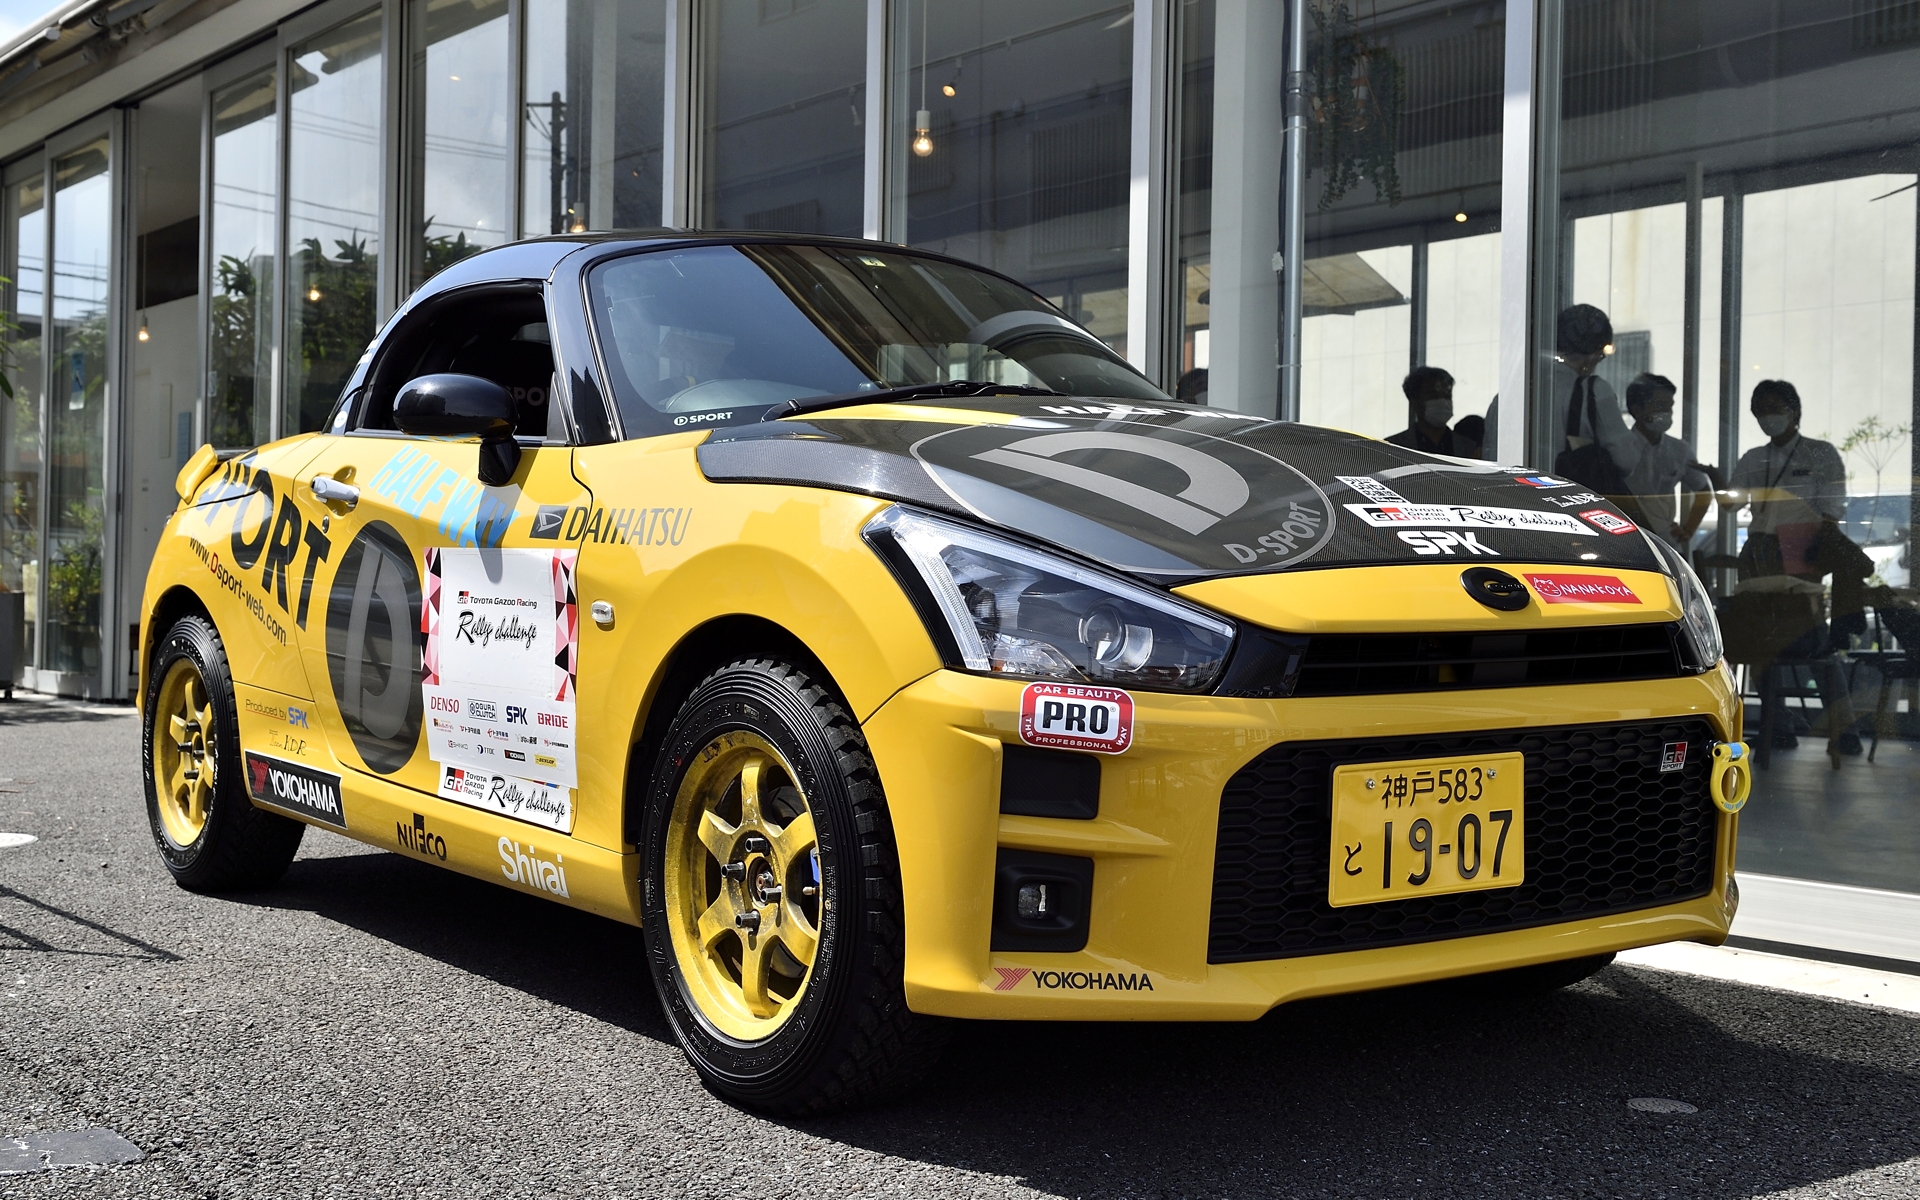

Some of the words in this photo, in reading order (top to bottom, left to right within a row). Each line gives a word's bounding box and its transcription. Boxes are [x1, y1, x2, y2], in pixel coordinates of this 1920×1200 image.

[689, 411, 733, 423] SPORT
[968, 430, 1250, 536] D
[368, 443, 460, 520] HALF
[438, 477, 521, 549] WAY
[564, 505, 693, 547] DAIHATSU
[1450, 507, 1516, 527] Rally
[1221, 501, 1322, 565] D-SPORT
[1397, 530, 1501, 556] SPK
[196, 455, 332, 633] SPORT
[189, 533, 287, 647] www.Dsport-web.com
[1559, 583, 1633, 597] NANAKOYA
[470, 596, 493, 605] TOYOTA
[493, 597, 516, 606] GAZOO
[516, 598, 538, 609] Racing
[343, 539, 415, 739] D
[455, 610, 493, 647] Rally
[494, 614, 538, 649] challenge
[1033, 686, 1062, 694] CAR
[1067, 687, 1122, 701] BEAUTY
[245, 698, 278, 717] Produced
[278, 707, 287, 721] by
[430, 696, 460, 714] DENSO
[475, 702, 496, 712] OGURA
[475, 709, 496, 719] CLUTCH
[506, 705, 528, 725] SPK
[288, 706, 309, 730] SPK
[537, 712, 569, 729] BRIDE
[1025, 717, 1034, 738] THE
[1042, 701, 1110, 735] PRO
[283, 734, 307, 756] KDR
[1035, 736, 1113, 750] PROFESSIONAL
[1115, 726, 1129, 747] WAY
[1664, 751, 1684, 763] GR
[444, 775, 463, 793] GR
[464, 779, 485, 790] GAZOO
[465, 771, 487, 783] TOYOTA
[268, 767, 340, 815] YOKOHAMA
[463, 786, 483, 799] Racing
[487, 775, 524, 814] Rally
[525, 788, 566, 825] challenge
[396, 812, 447, 862] NIFCO
[1343, 841, 1364, 876] と
[1381, 809, 1514, 889] 19-07
[497, 836, 570, 899] Shirai
[1031, 970, 1154, 991] YOKOHAMA
